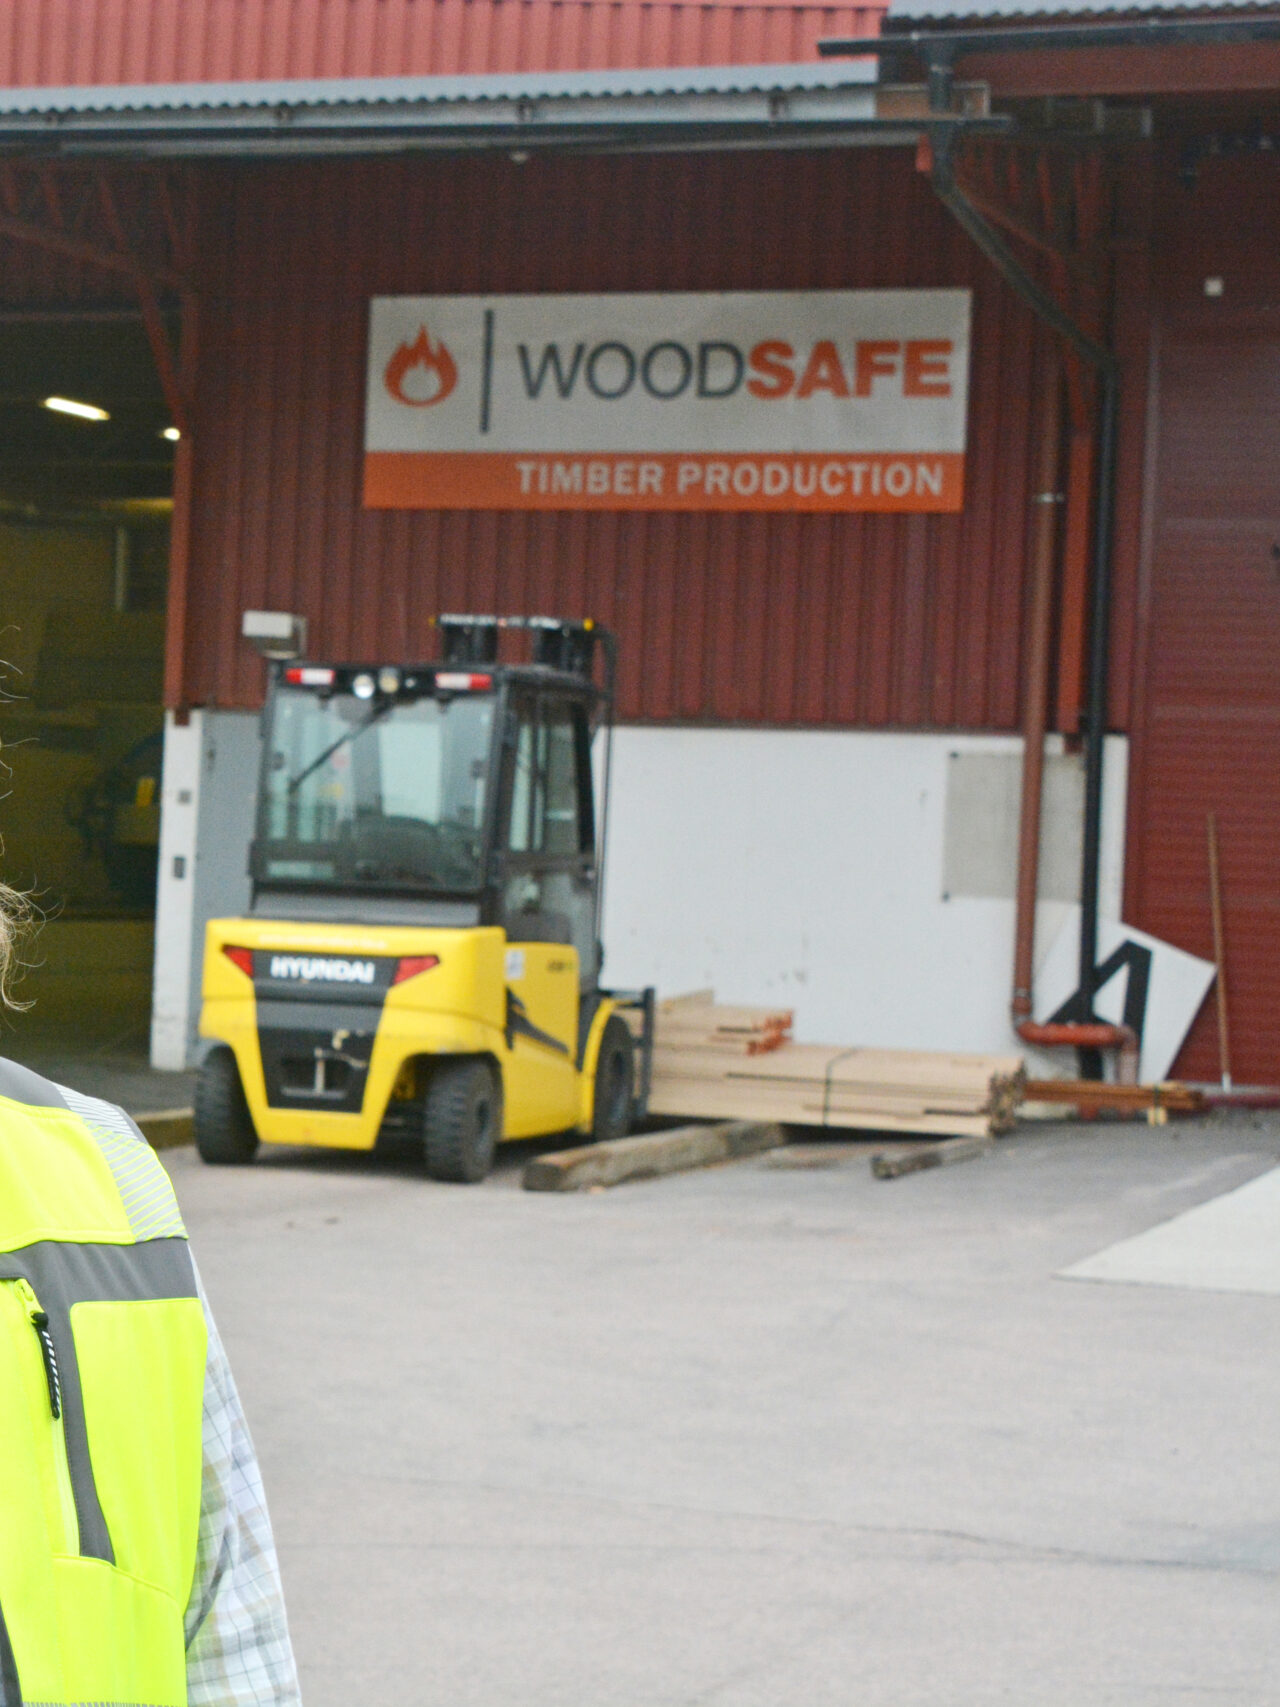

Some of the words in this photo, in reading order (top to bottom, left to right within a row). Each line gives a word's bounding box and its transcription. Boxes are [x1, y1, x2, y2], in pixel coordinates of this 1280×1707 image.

[517, 338, 953, 400] WOODSAFE
[516, 461, 663, 495] TIMBER
[677, 460, 943, 497] PRODUCTION
[271, 956, 375, 984] HYUNDAI
